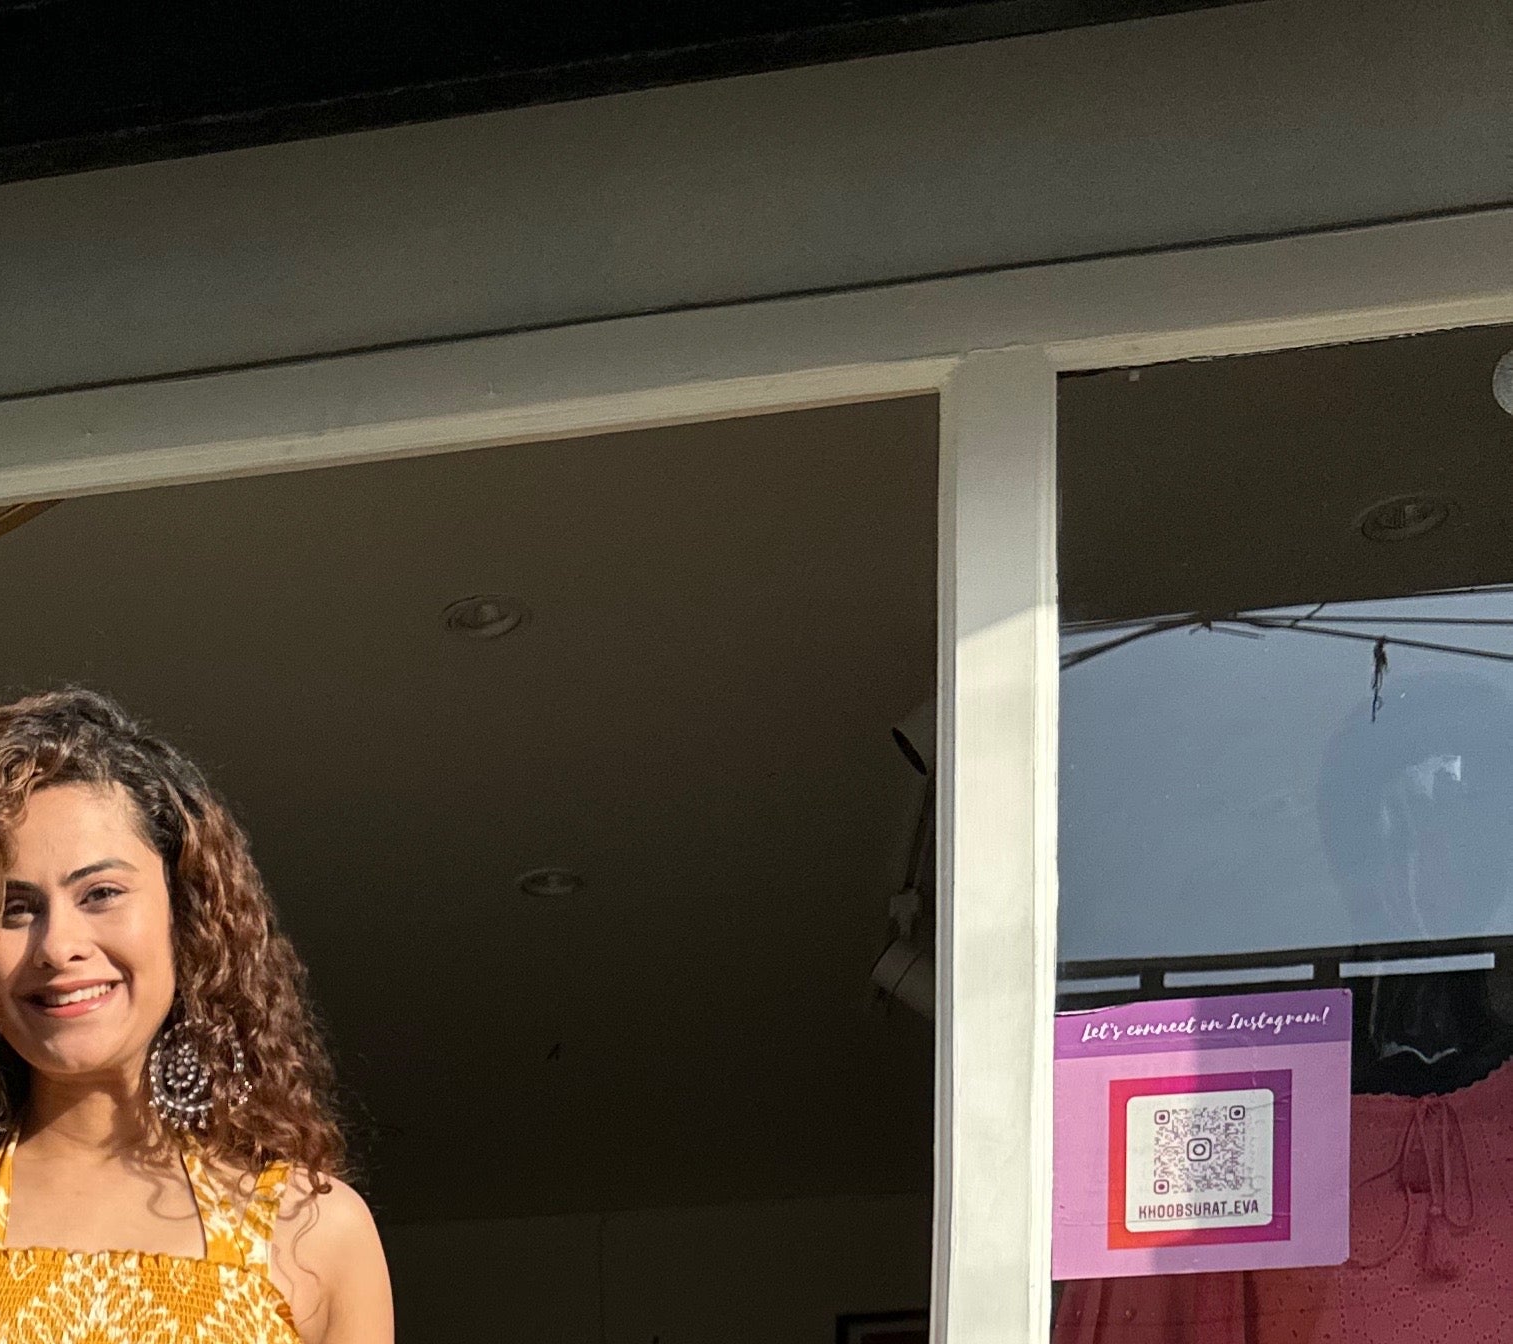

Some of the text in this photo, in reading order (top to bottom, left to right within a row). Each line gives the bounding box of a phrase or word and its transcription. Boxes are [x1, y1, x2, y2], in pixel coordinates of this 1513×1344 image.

[1081, 1006, 1330, 1042] Let's connect on Instagram!
[1138, 1199, 1259, 1219] KHOOBSURAT_EVA
